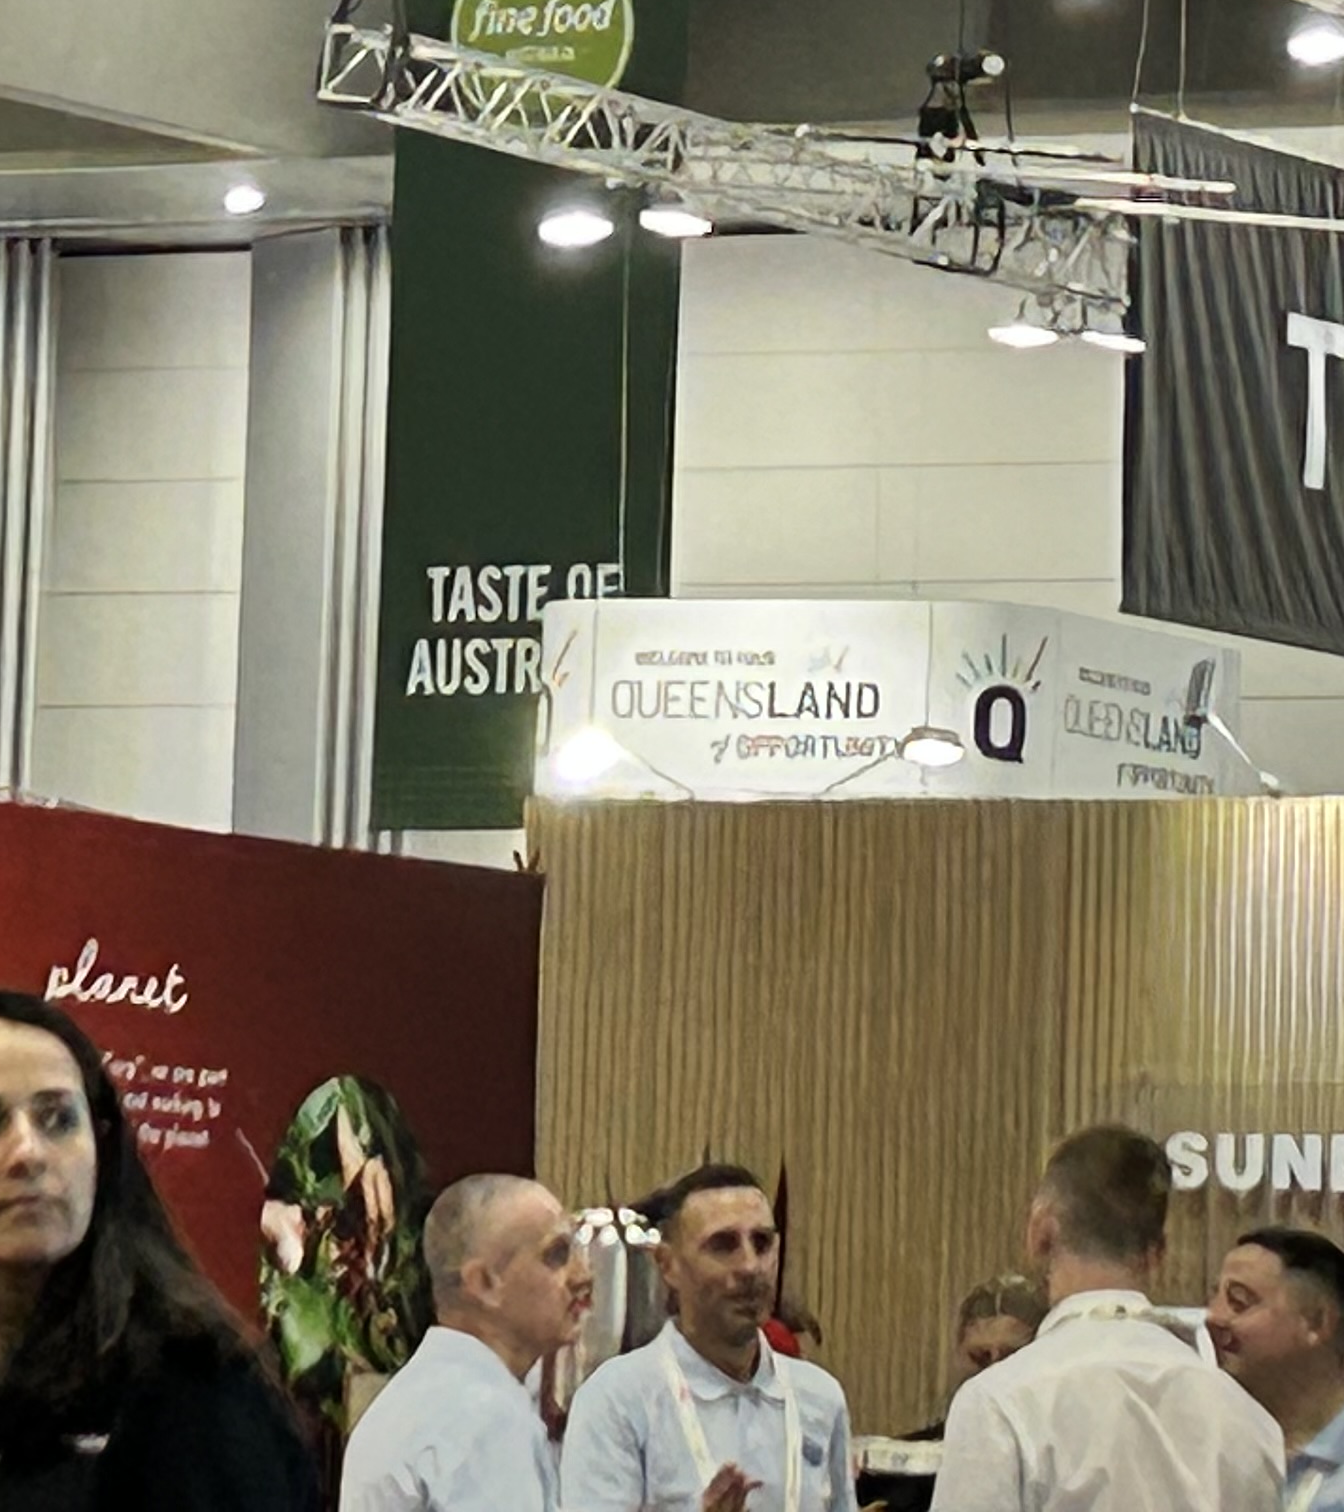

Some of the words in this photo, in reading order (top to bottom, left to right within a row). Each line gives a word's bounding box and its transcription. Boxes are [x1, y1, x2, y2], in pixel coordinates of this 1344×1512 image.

[426, 564, 552, 623] TASTE
[567, 562, 623, 600] OF
[611, 679, 880, 720] QUEENSLAND
[973, 684, 1027, 765] Q
[44, 938, 189, 1016] planet
